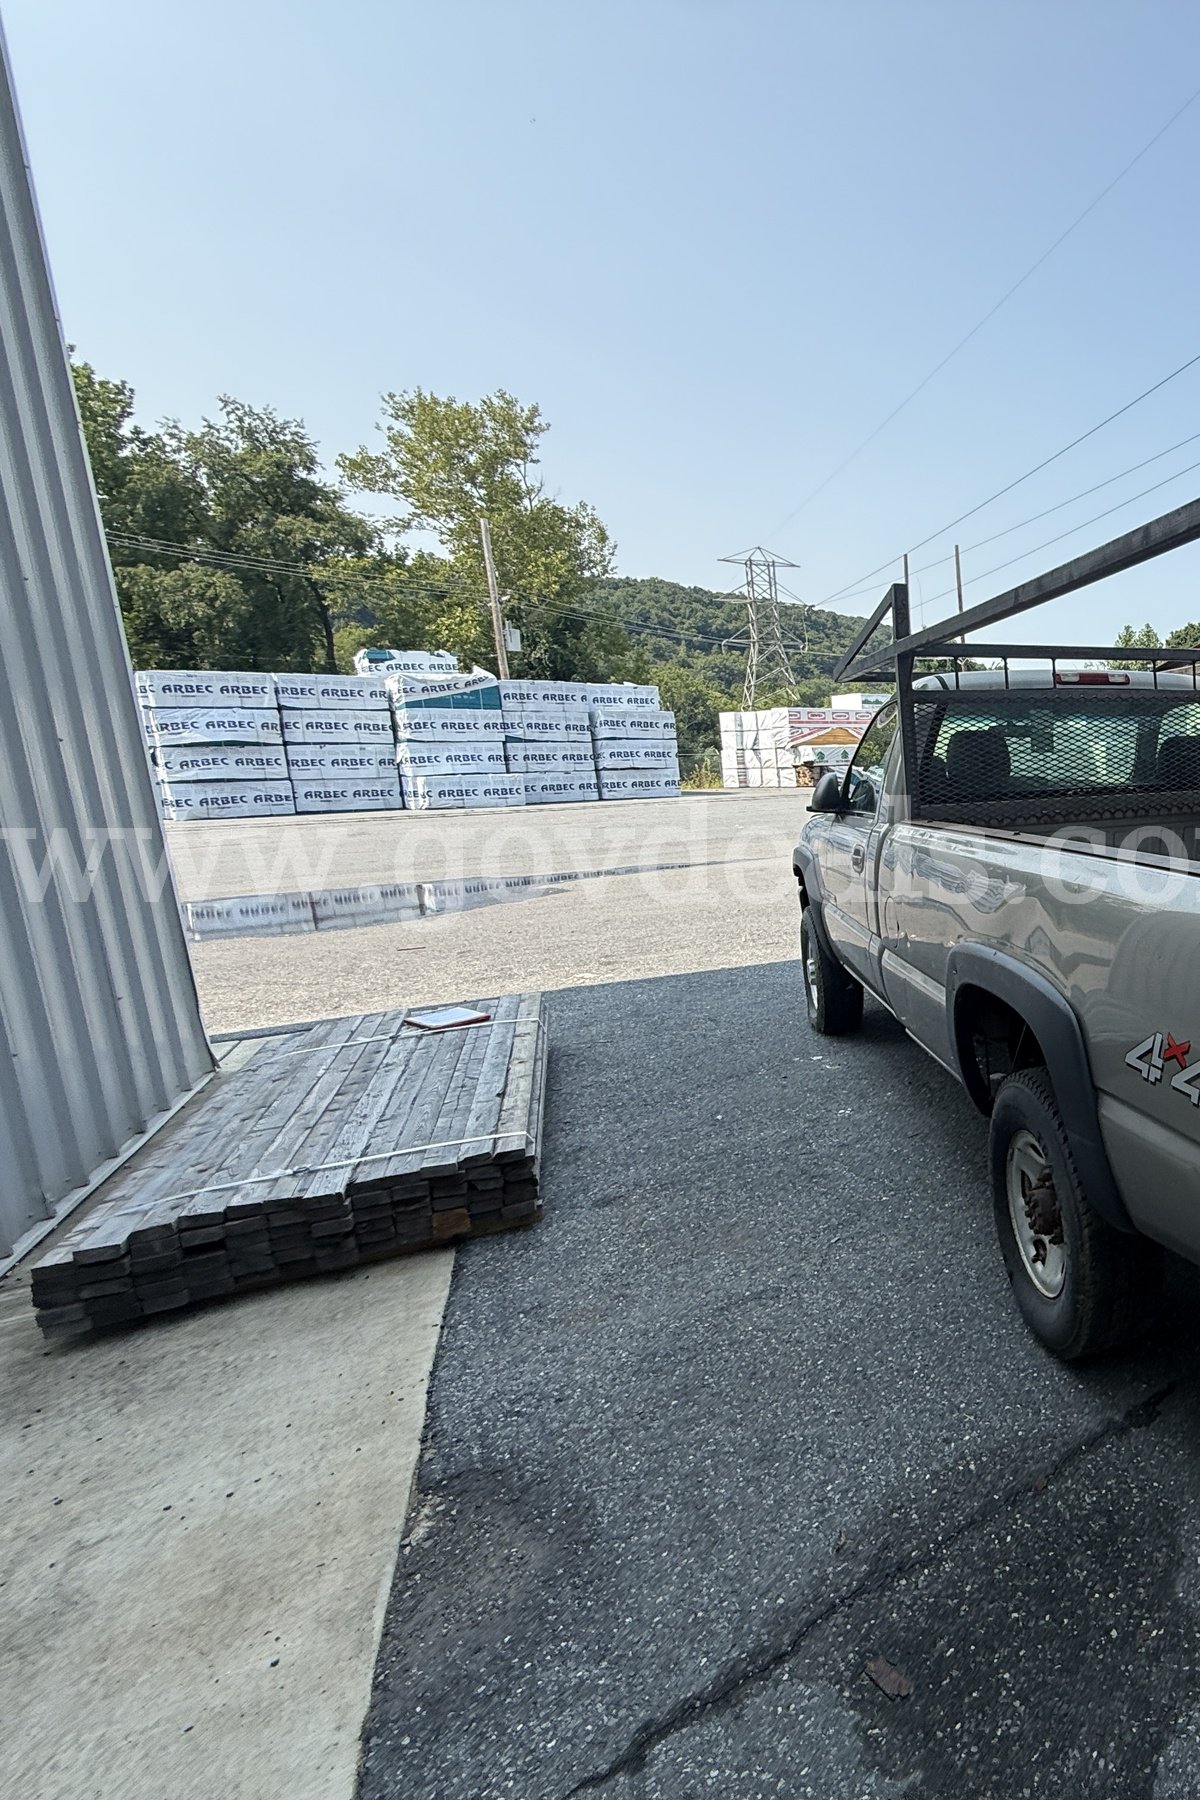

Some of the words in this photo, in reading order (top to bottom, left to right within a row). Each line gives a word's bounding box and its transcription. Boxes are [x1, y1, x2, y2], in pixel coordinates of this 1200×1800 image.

[386, 663, 423, 673] ARBEC
[162, 684, 213, 694] ARBEC
[220, 685, 269, 695] ARBEC
[321, 688, 365, 697] ARBEC
[421, 682, 460, 694] ARBEC
[503, 692, 539, 701] ARBEC
[542, 693, 577, 702] ARBEC
[592, 696, 624, 705] ARBEC
[627, 697, 655, 705] ARBEC
[205, 720, 256, 730] ARBEC
[305, 721, 349, 731] ARBEC
[441, 722, 480, 730] ARBEC
[526, 722, 561, 731] ARBEC
[630, 720, 660, 729] ARBEC
[446, 754, 484, 763] ARBEC
[523, 753, 558, 762] ARBEC
[609, 750, 641, 759] ARBEC
[644, 751, 672, 759] ARBEC
[180, 757, 228, 770] ARBEC
[235, 757, 282, 767] ARBEC
[330, 758, 374, 767] ARBEC
[541, 783, 575, 793] ARBEC
[631, 780, 662, 788] ARBEC
[304, 790, 348, 799] ARBEC
[352, 789, 394, 798] ARBEC
[438, 788, 478, 798] ARBEC
[483, 787, 522, 797] ARBEC
[199, 795, 249, 807] ARBEC
